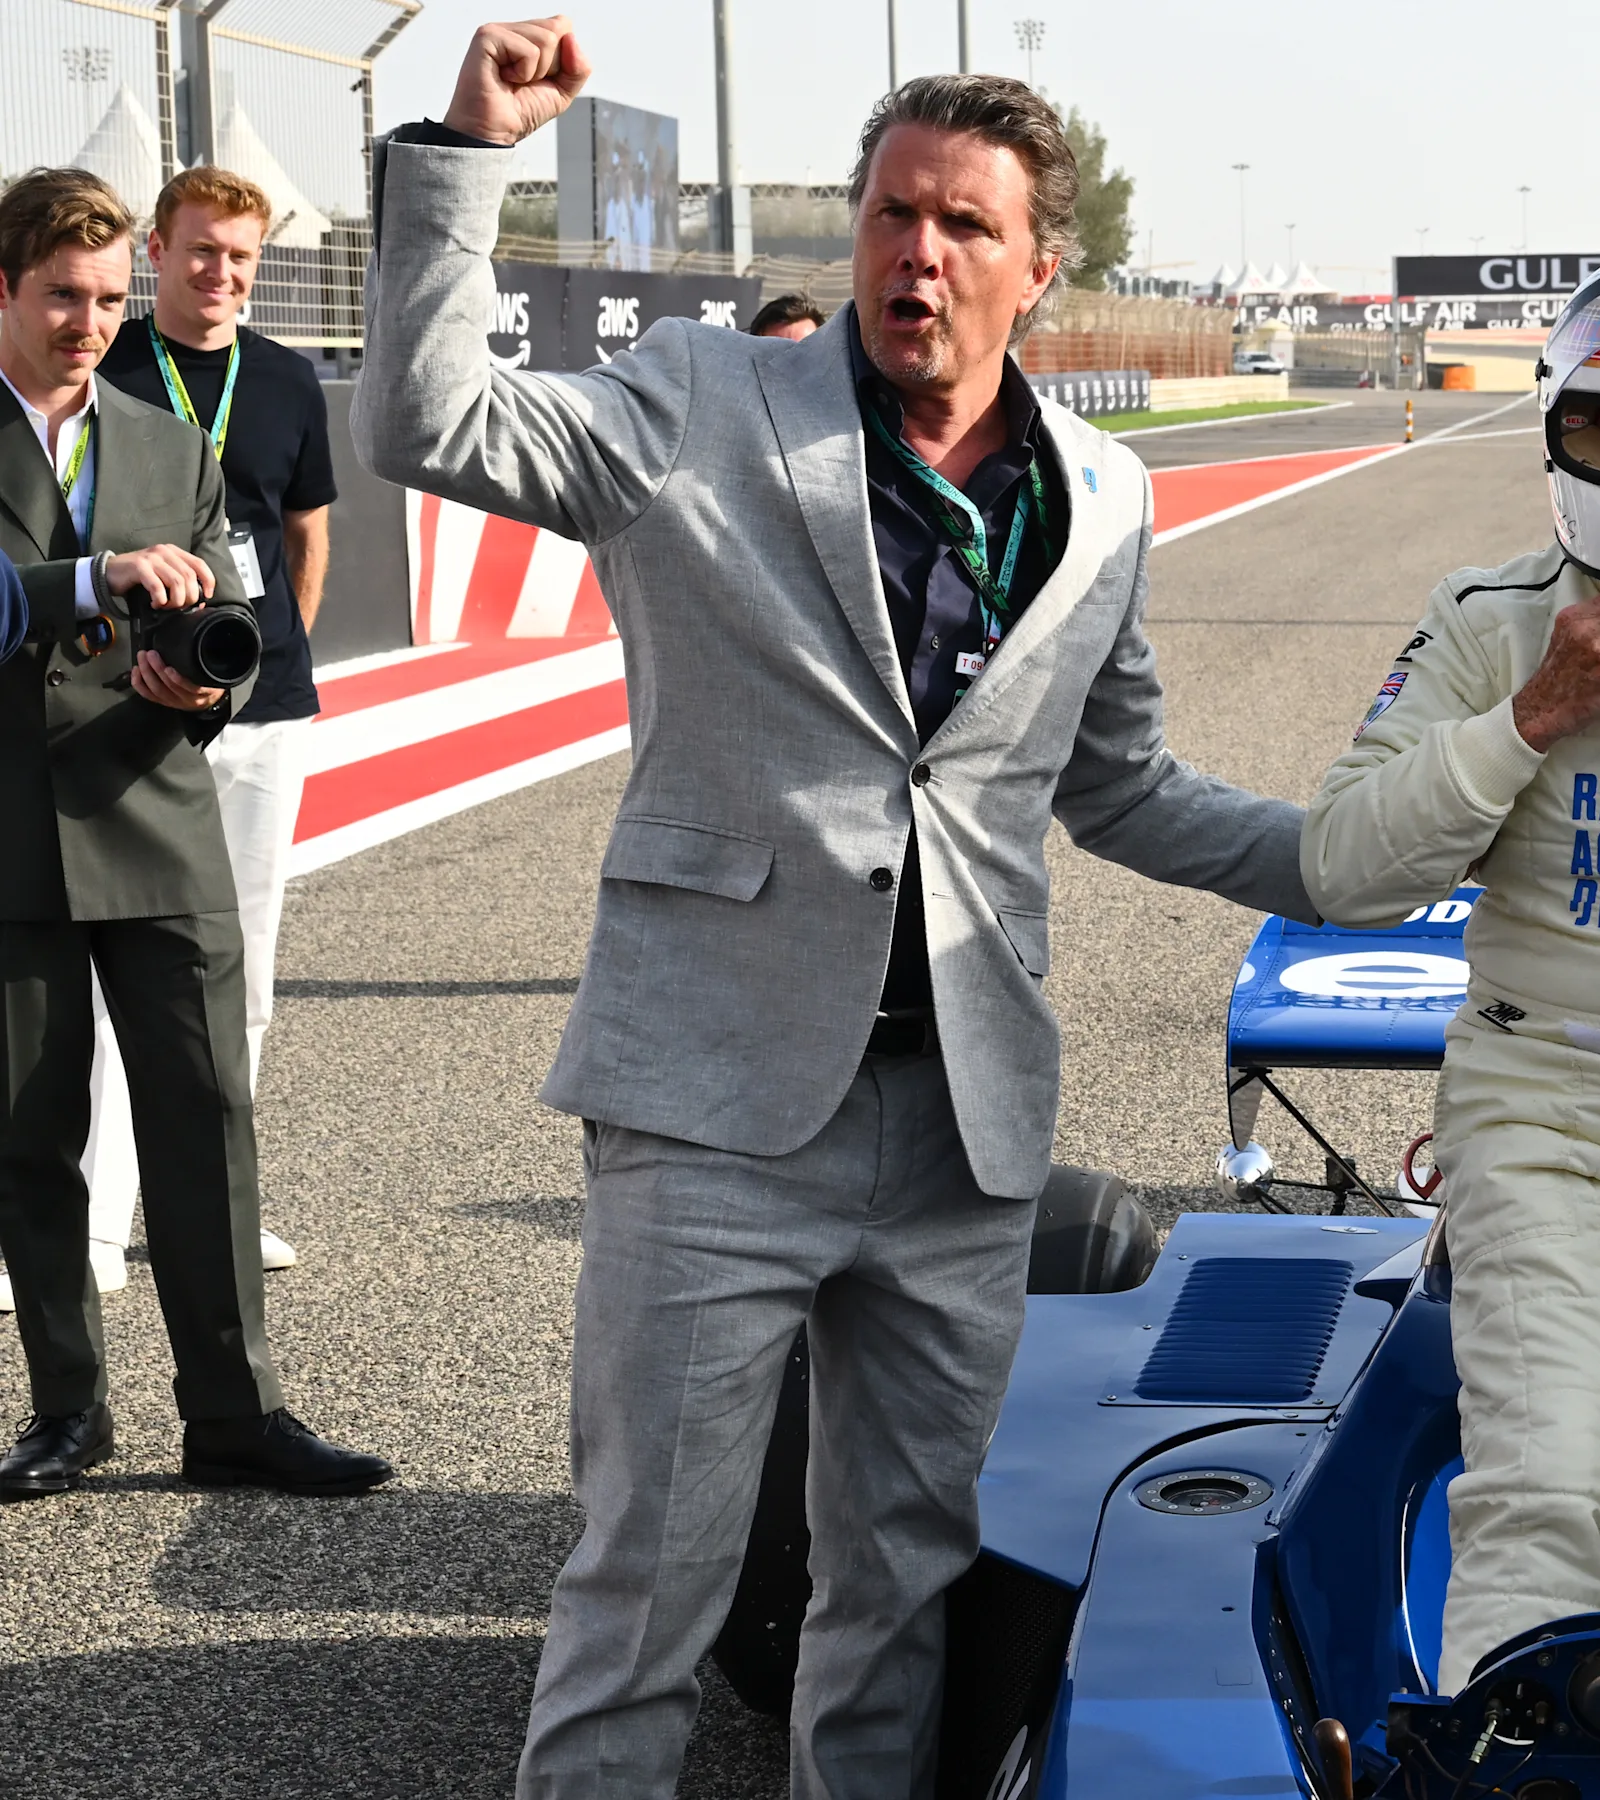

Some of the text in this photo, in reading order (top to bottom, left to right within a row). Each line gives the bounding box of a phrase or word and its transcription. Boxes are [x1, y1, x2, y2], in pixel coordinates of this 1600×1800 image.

[597, 296, 640, 338] aws
[1434, 301, 1477, 323] AIR
[1566, 417, 1587, 425] BELL
